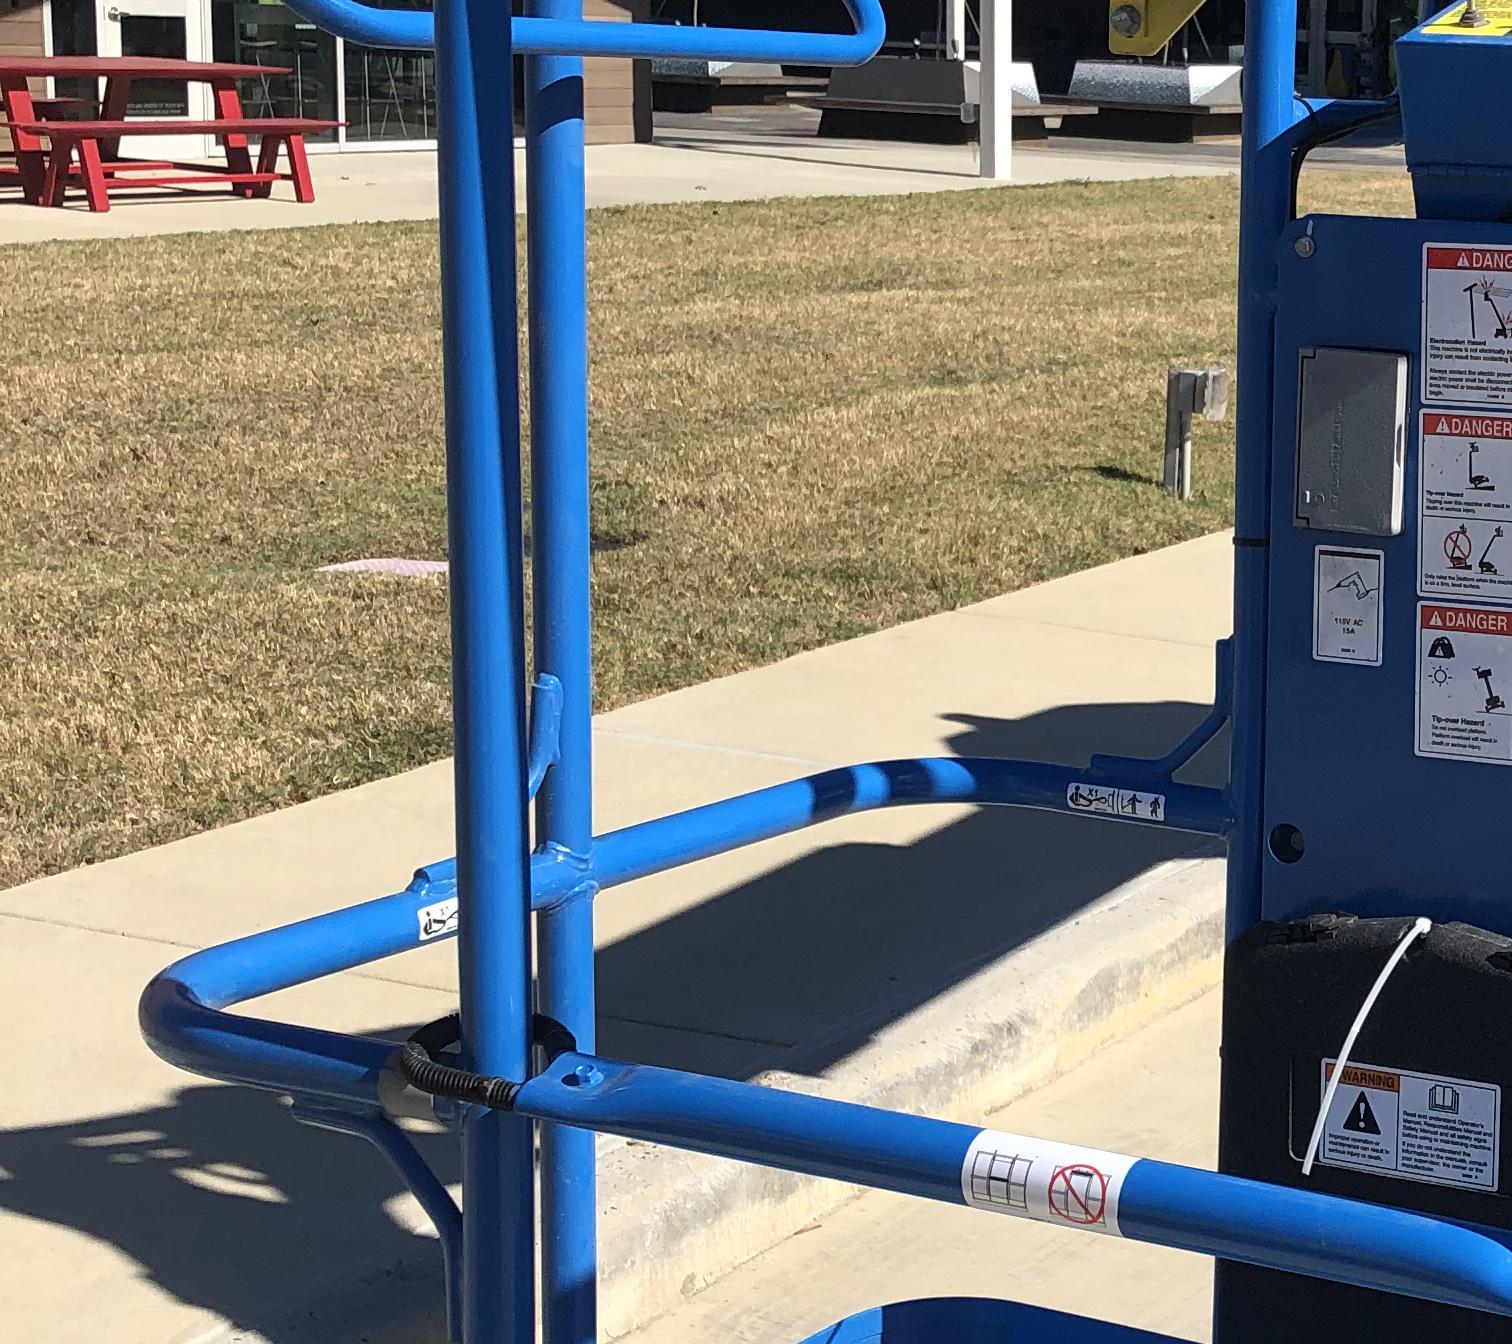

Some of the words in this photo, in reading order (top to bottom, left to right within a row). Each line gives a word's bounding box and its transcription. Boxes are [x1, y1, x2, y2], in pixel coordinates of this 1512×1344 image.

[1452, 419, 1512, 438] DANGER
[1445, 611, 1508, 631] DANGER
[1341, 1070, 1394, 1088] WARNING
